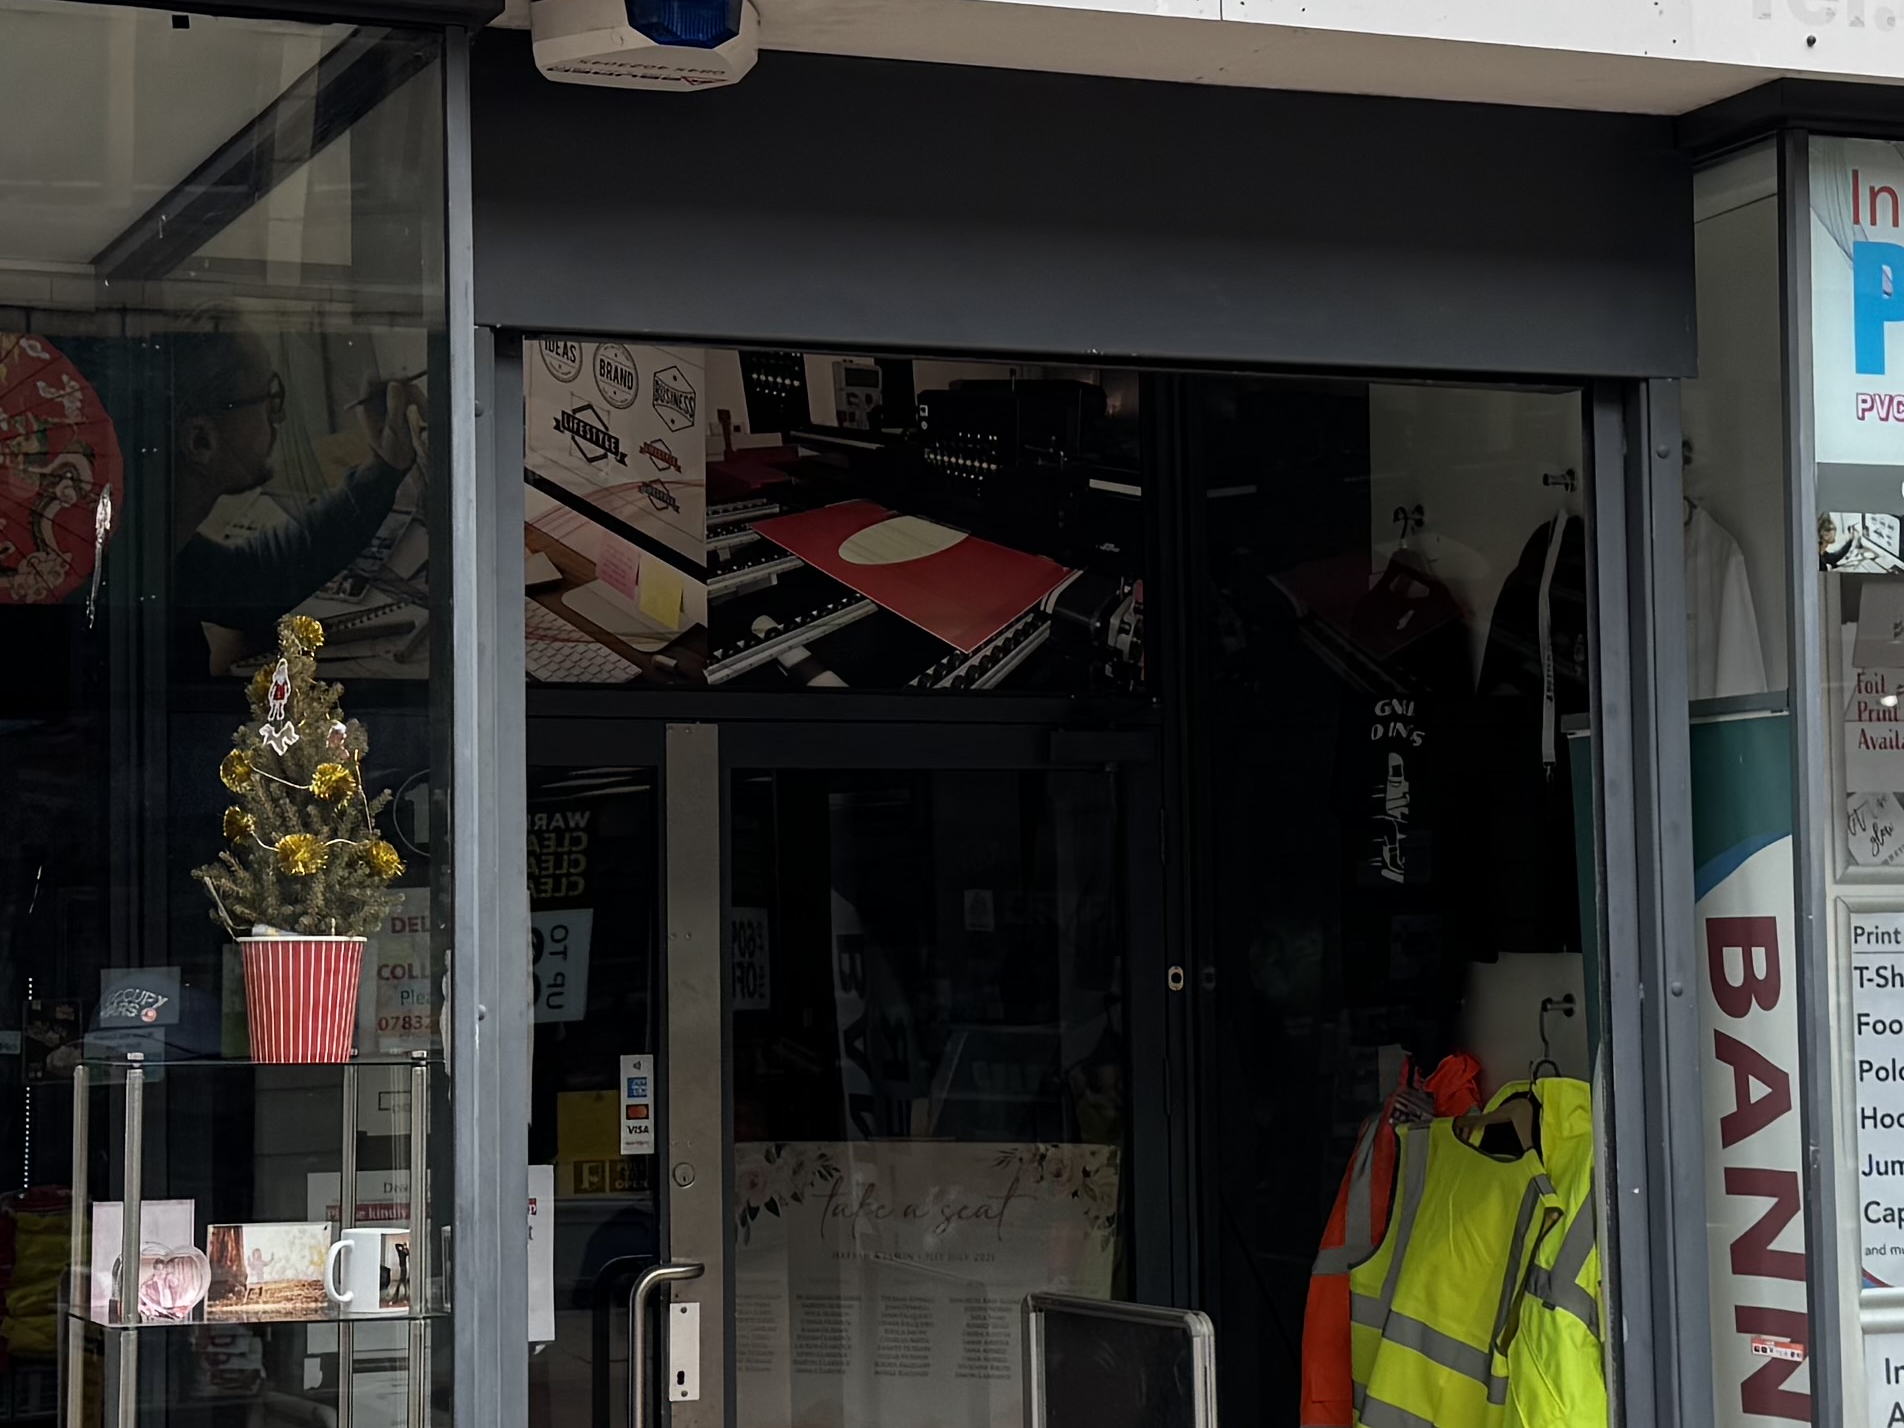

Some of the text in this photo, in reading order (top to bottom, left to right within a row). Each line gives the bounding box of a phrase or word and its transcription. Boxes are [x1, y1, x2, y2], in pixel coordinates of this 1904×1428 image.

[599, 359, 634, 390] BRAND
[654, 379, 695, 418] BUSINESS
[561, 412, 618, 454] LIFESTYLE
[1853, 925, 1902, 945] Print
[812, 1165, 1038, 1242] take a seat
[1864, 1244, 1887, 1256] and
